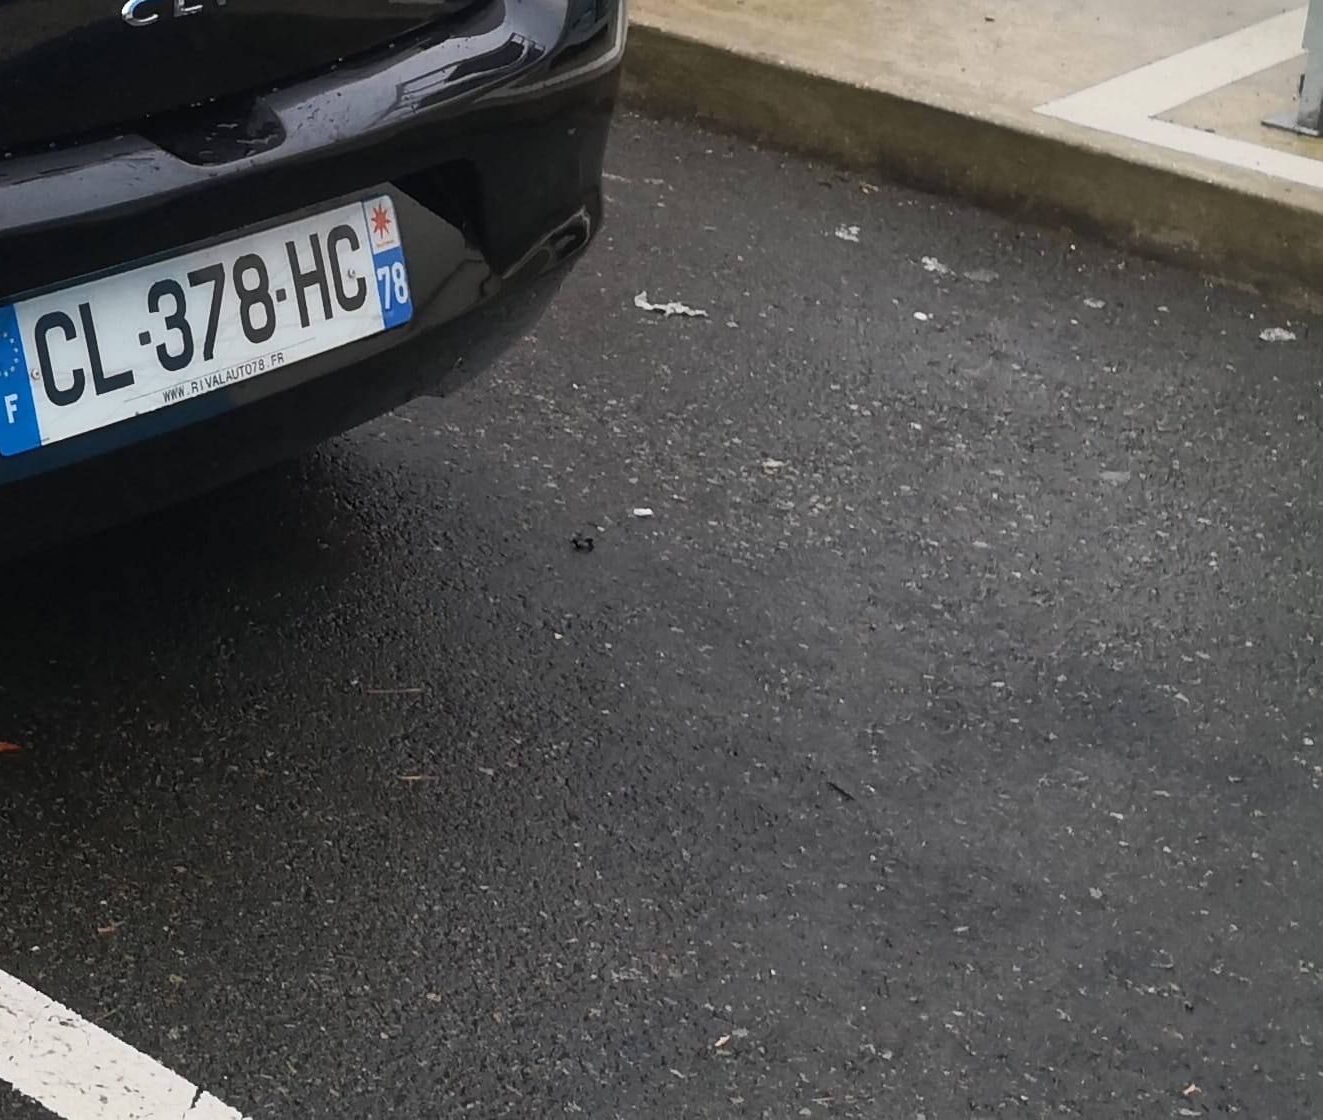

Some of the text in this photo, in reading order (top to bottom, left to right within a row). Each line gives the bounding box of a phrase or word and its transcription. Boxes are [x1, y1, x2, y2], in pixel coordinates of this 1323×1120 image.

[376, 261, 409, 310] 78
[162, 352, 285, 403] WWW.RIVALAUTO78.FR
[3, 392, 19, 424] F
